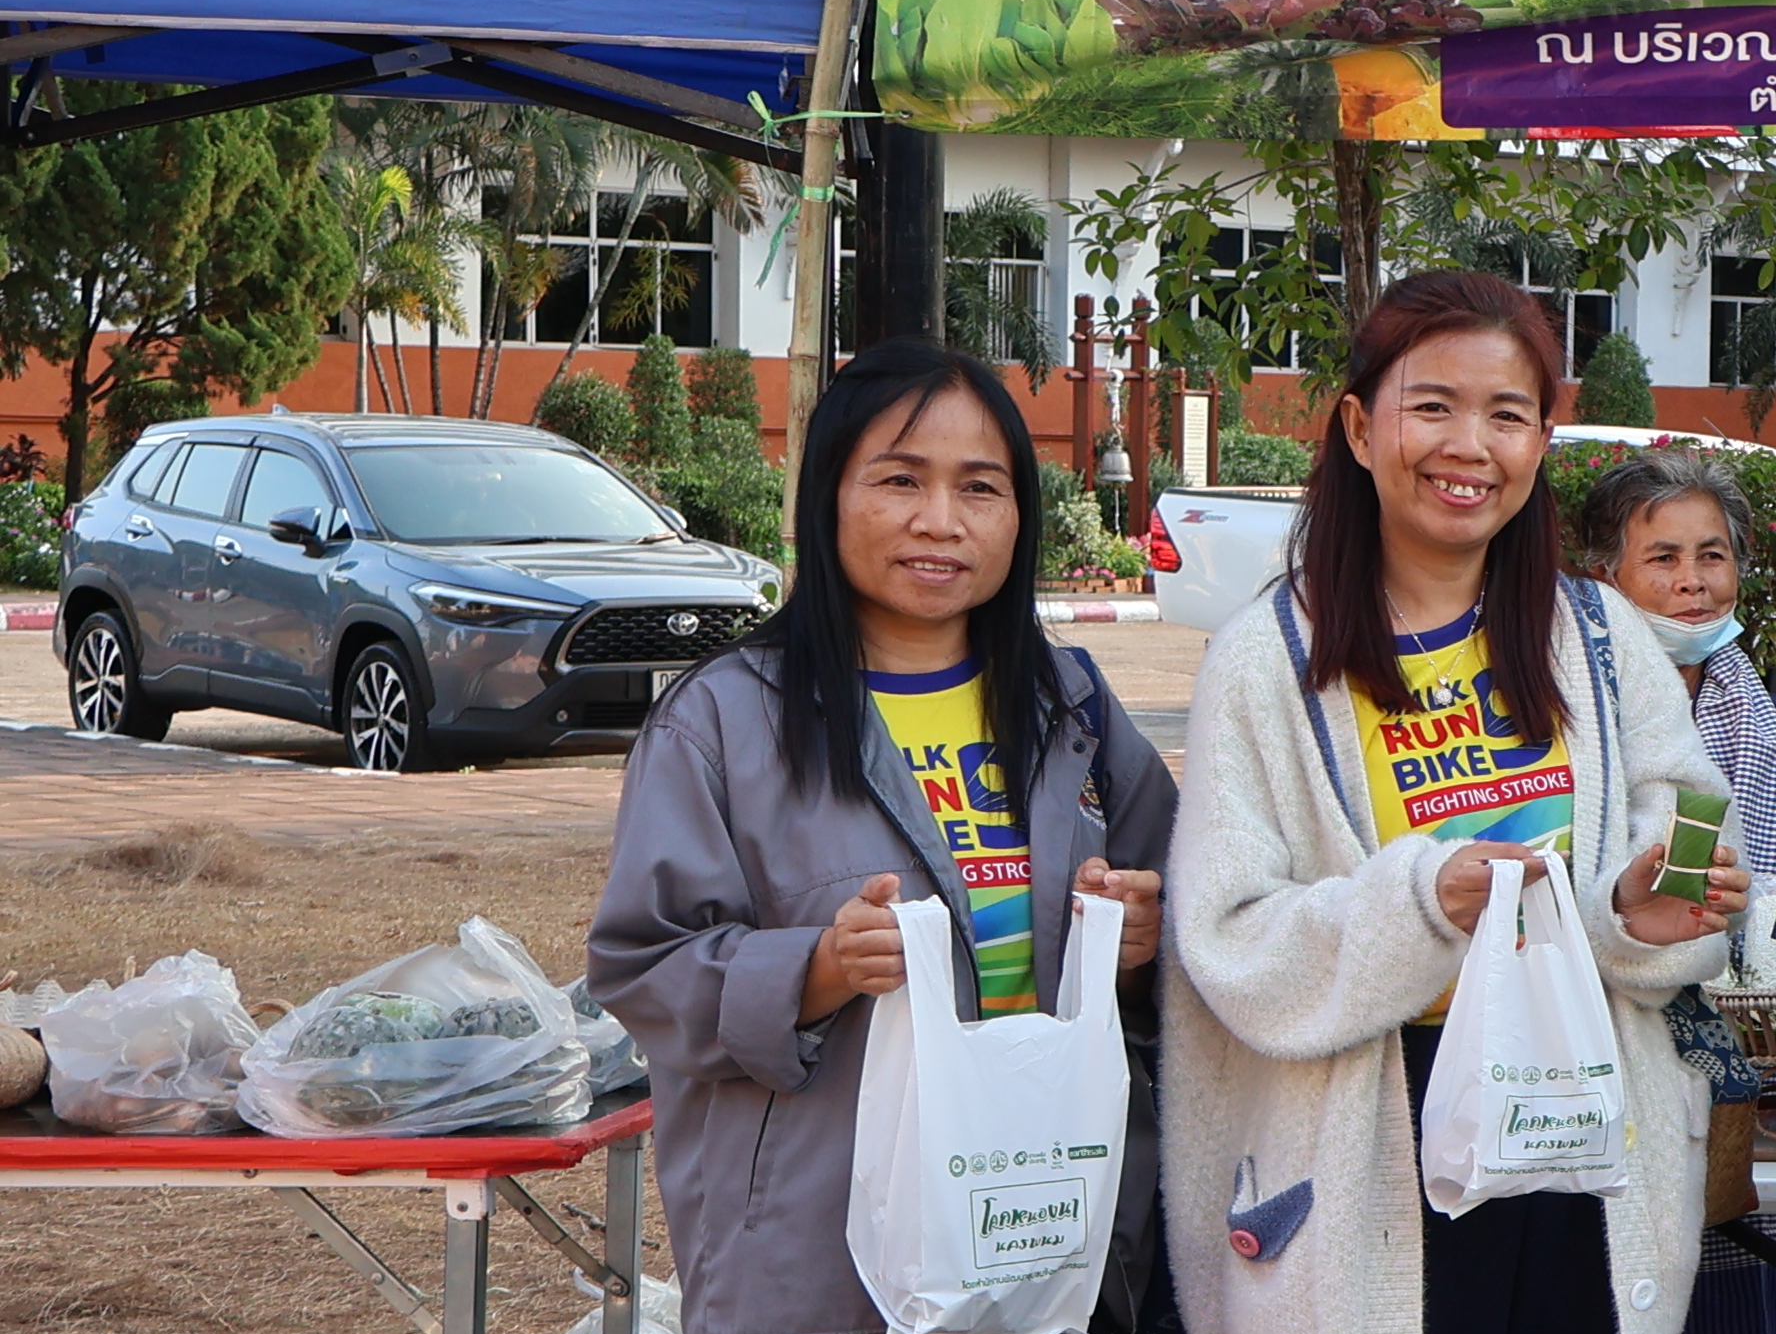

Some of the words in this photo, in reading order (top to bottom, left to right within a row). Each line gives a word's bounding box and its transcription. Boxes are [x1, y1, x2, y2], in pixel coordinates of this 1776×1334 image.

[1536, 34, 1593, 64] ณ
[1380, 704, 1481, 755] RUN
[902, 743, 953, 772] LK
[1392, 745, 1491, 793] BIKE
[1411, 784, 1499, 820] FIGHTING
[1501, 771, 1570, 798] STROKE
[983, 863, 1031, 882] STRO
